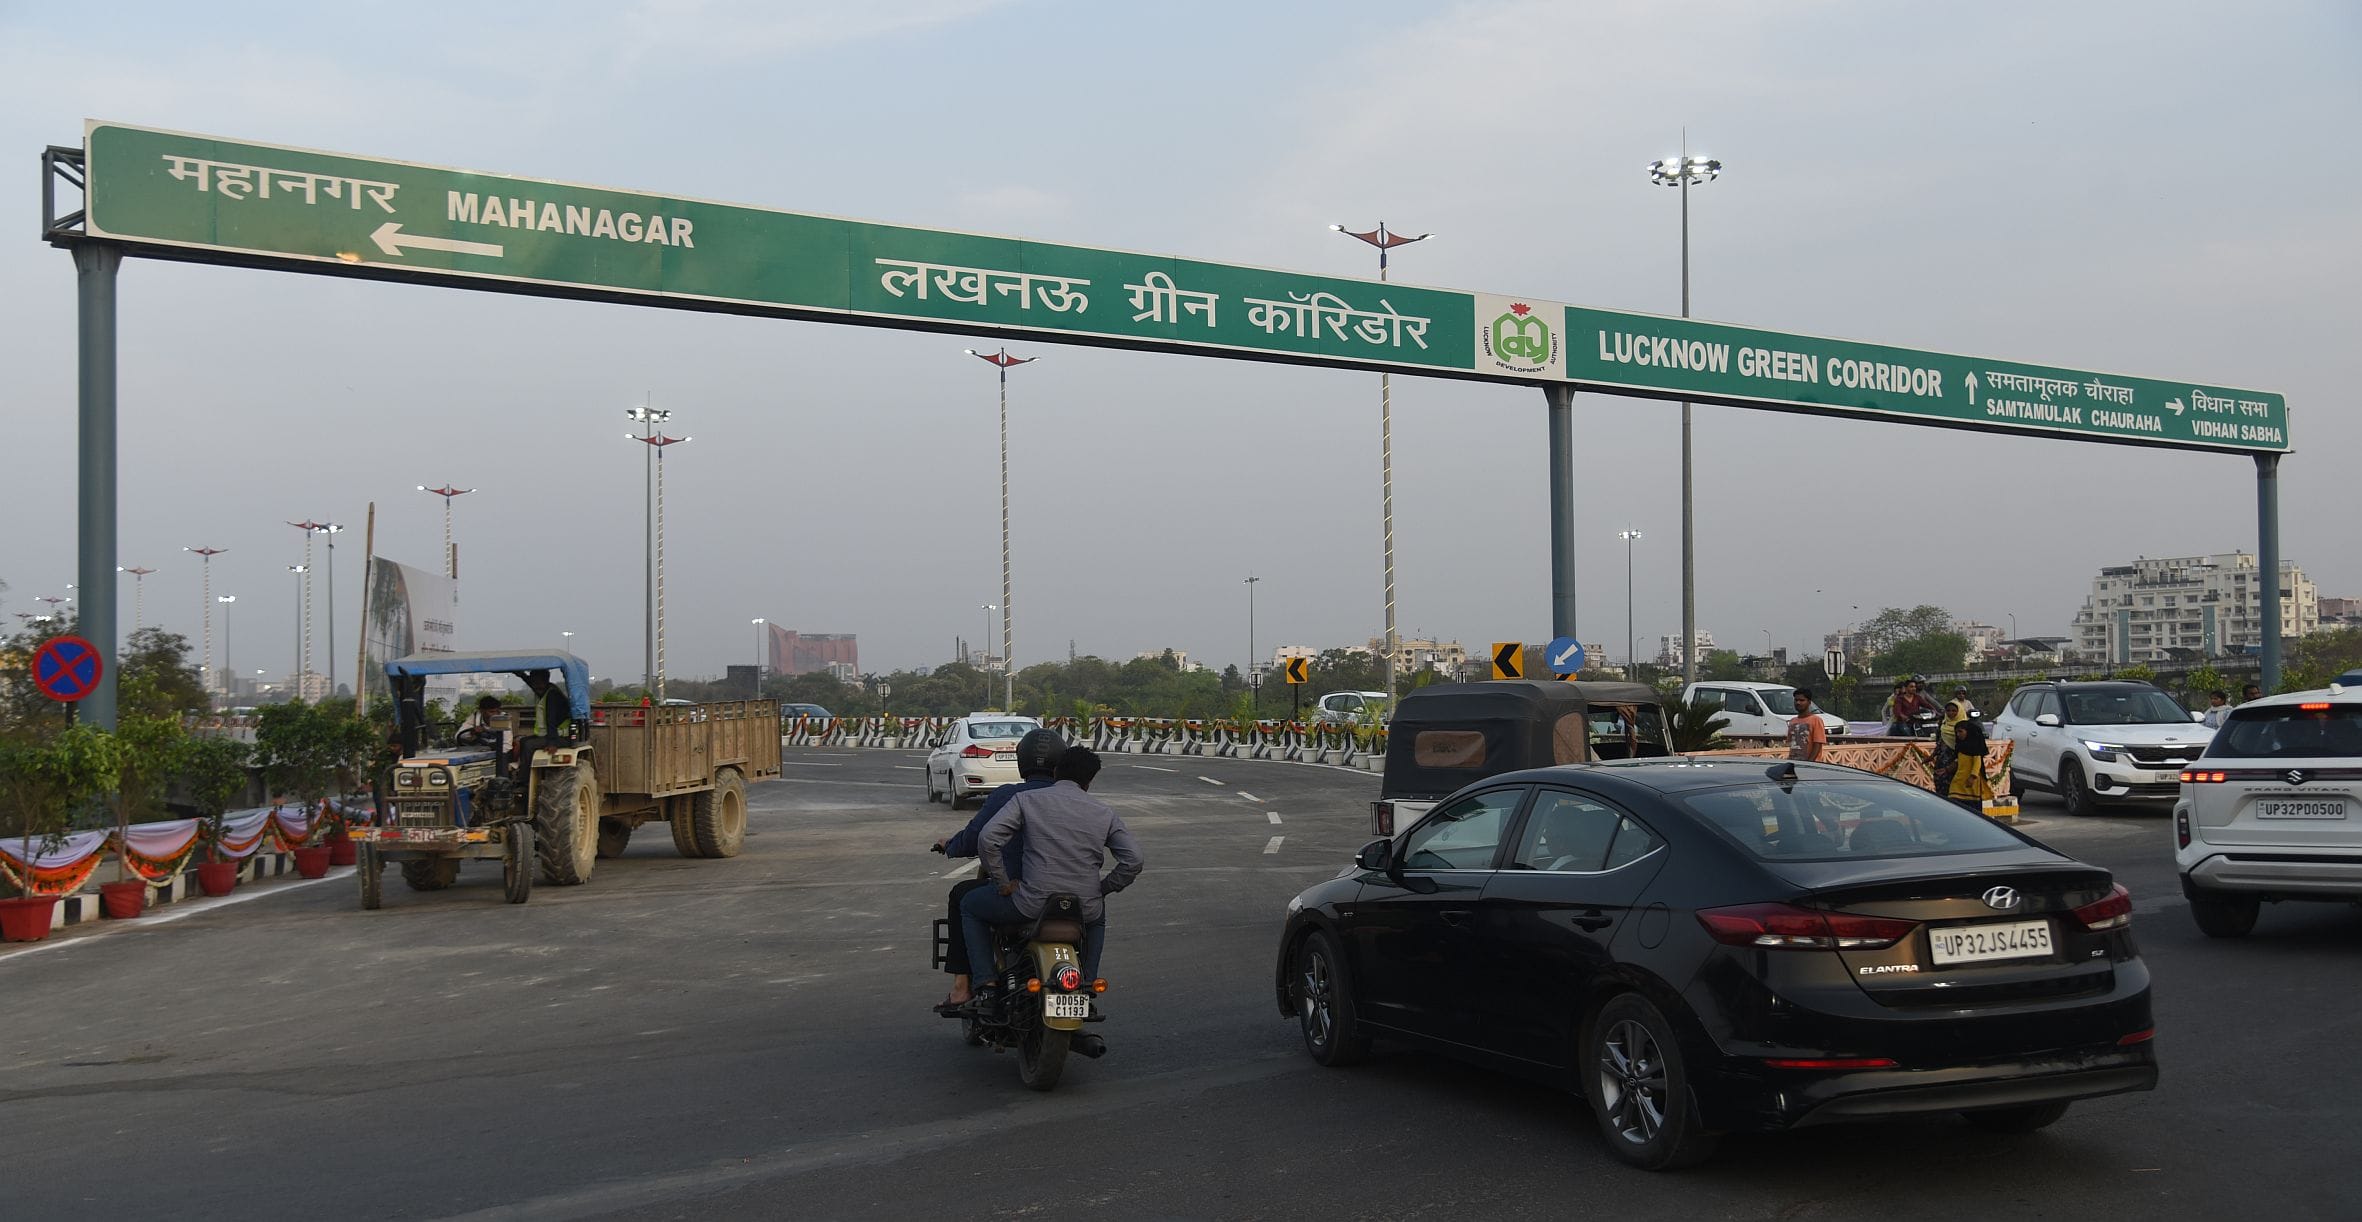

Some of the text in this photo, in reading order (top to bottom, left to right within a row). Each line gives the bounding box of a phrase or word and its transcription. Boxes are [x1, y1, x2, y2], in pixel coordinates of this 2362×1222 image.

[162, 154, 400, 214] महानगर
[447, 190, 695, 249] MAHANAGAR
[874, 257, 1091, 314] लखनऊ
[1123, 270, 1220, 328] ग्रीन
[1244, 291, 1431, 350] कॉरिडोर
[1496, 361, 1546, 373] DEVELOPMENT
[1599, 330, 1943, 398] LUCKNOW GREEN CORRIDOR
[1985, 371, 2134, 405] समतामूलक चौराहा
[2190, 389, 2269, 418] विधान सभा
[1986, 398, 2162, 432] SAMTAMULAK CHAURAHA
[2191, 419, 2282, 443] VIDHAN SABHA
[2264, 802, 2344, 817] UP32PD0500
[1945, 926, 2049, 957] UP32JS4455
[1859, 964, 1920, 976] ELANTRA
[1055, 1006, 1085, 1017] C1193
